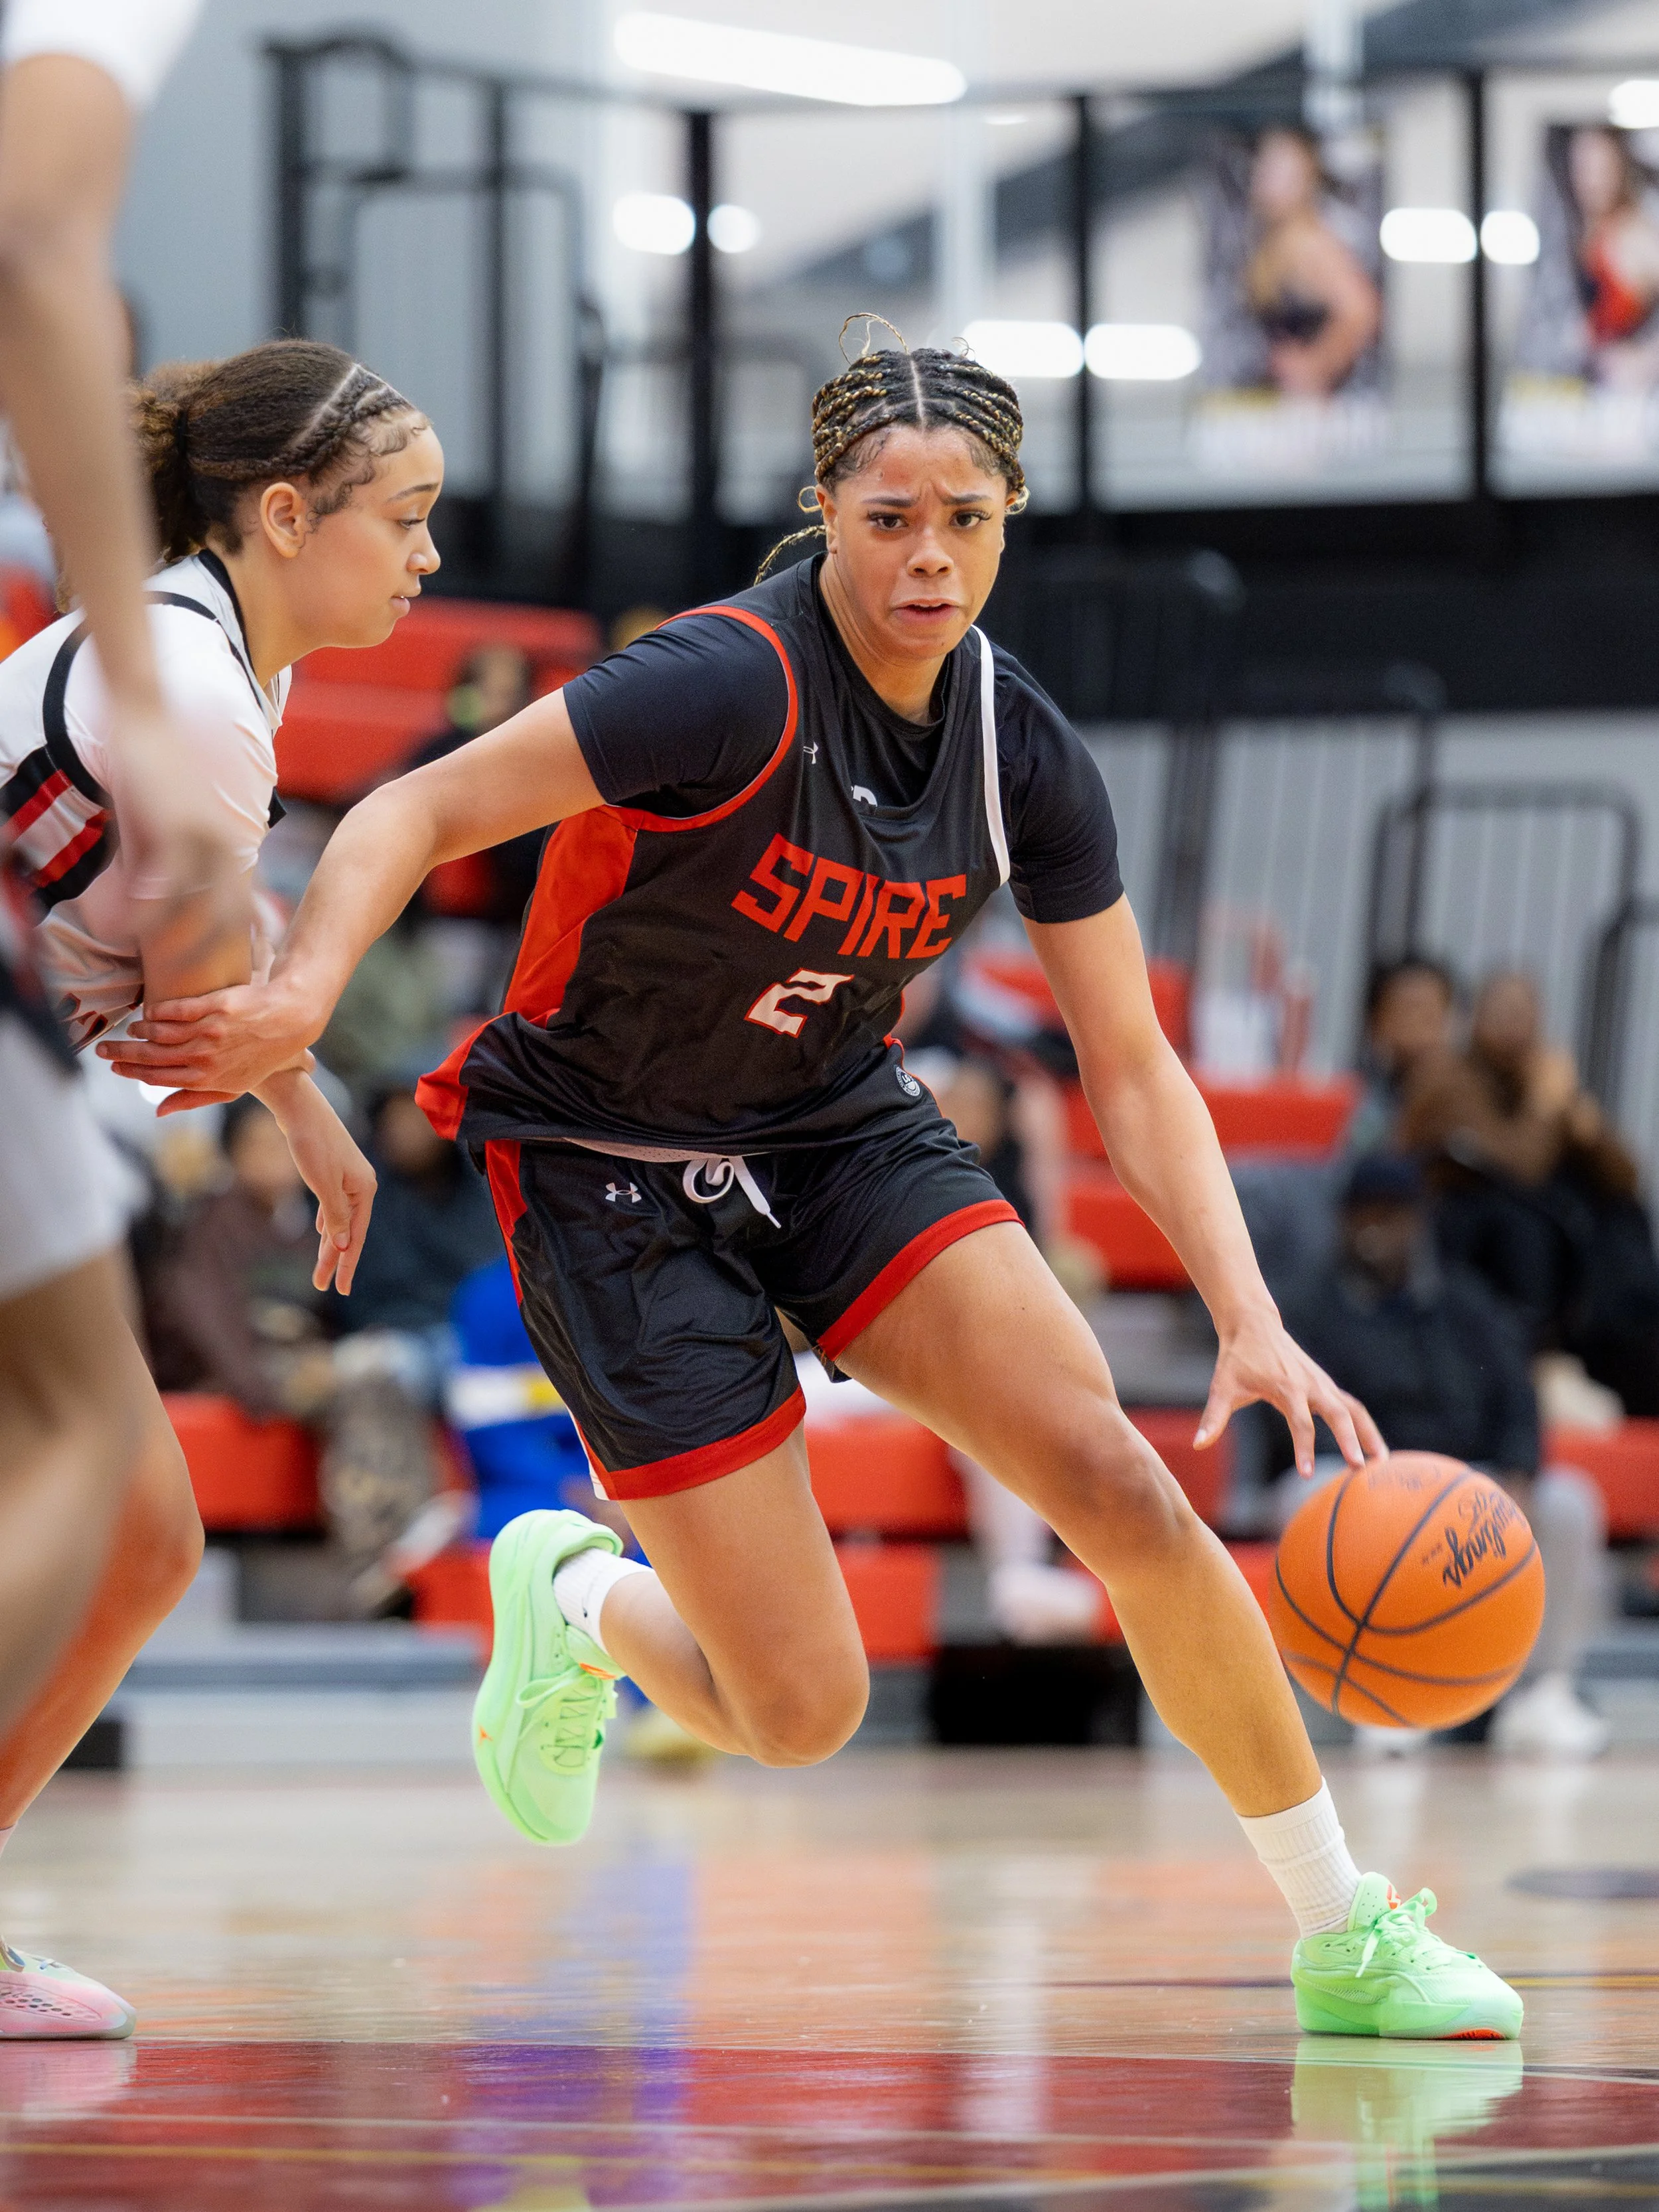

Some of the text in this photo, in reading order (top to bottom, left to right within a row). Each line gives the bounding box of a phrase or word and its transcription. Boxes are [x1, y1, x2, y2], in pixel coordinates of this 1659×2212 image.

[731, 832, 966, 959] SPIRE
[744, 968, 855, 1038] 2
[1442, 1493, 1528, 1589] wlings
